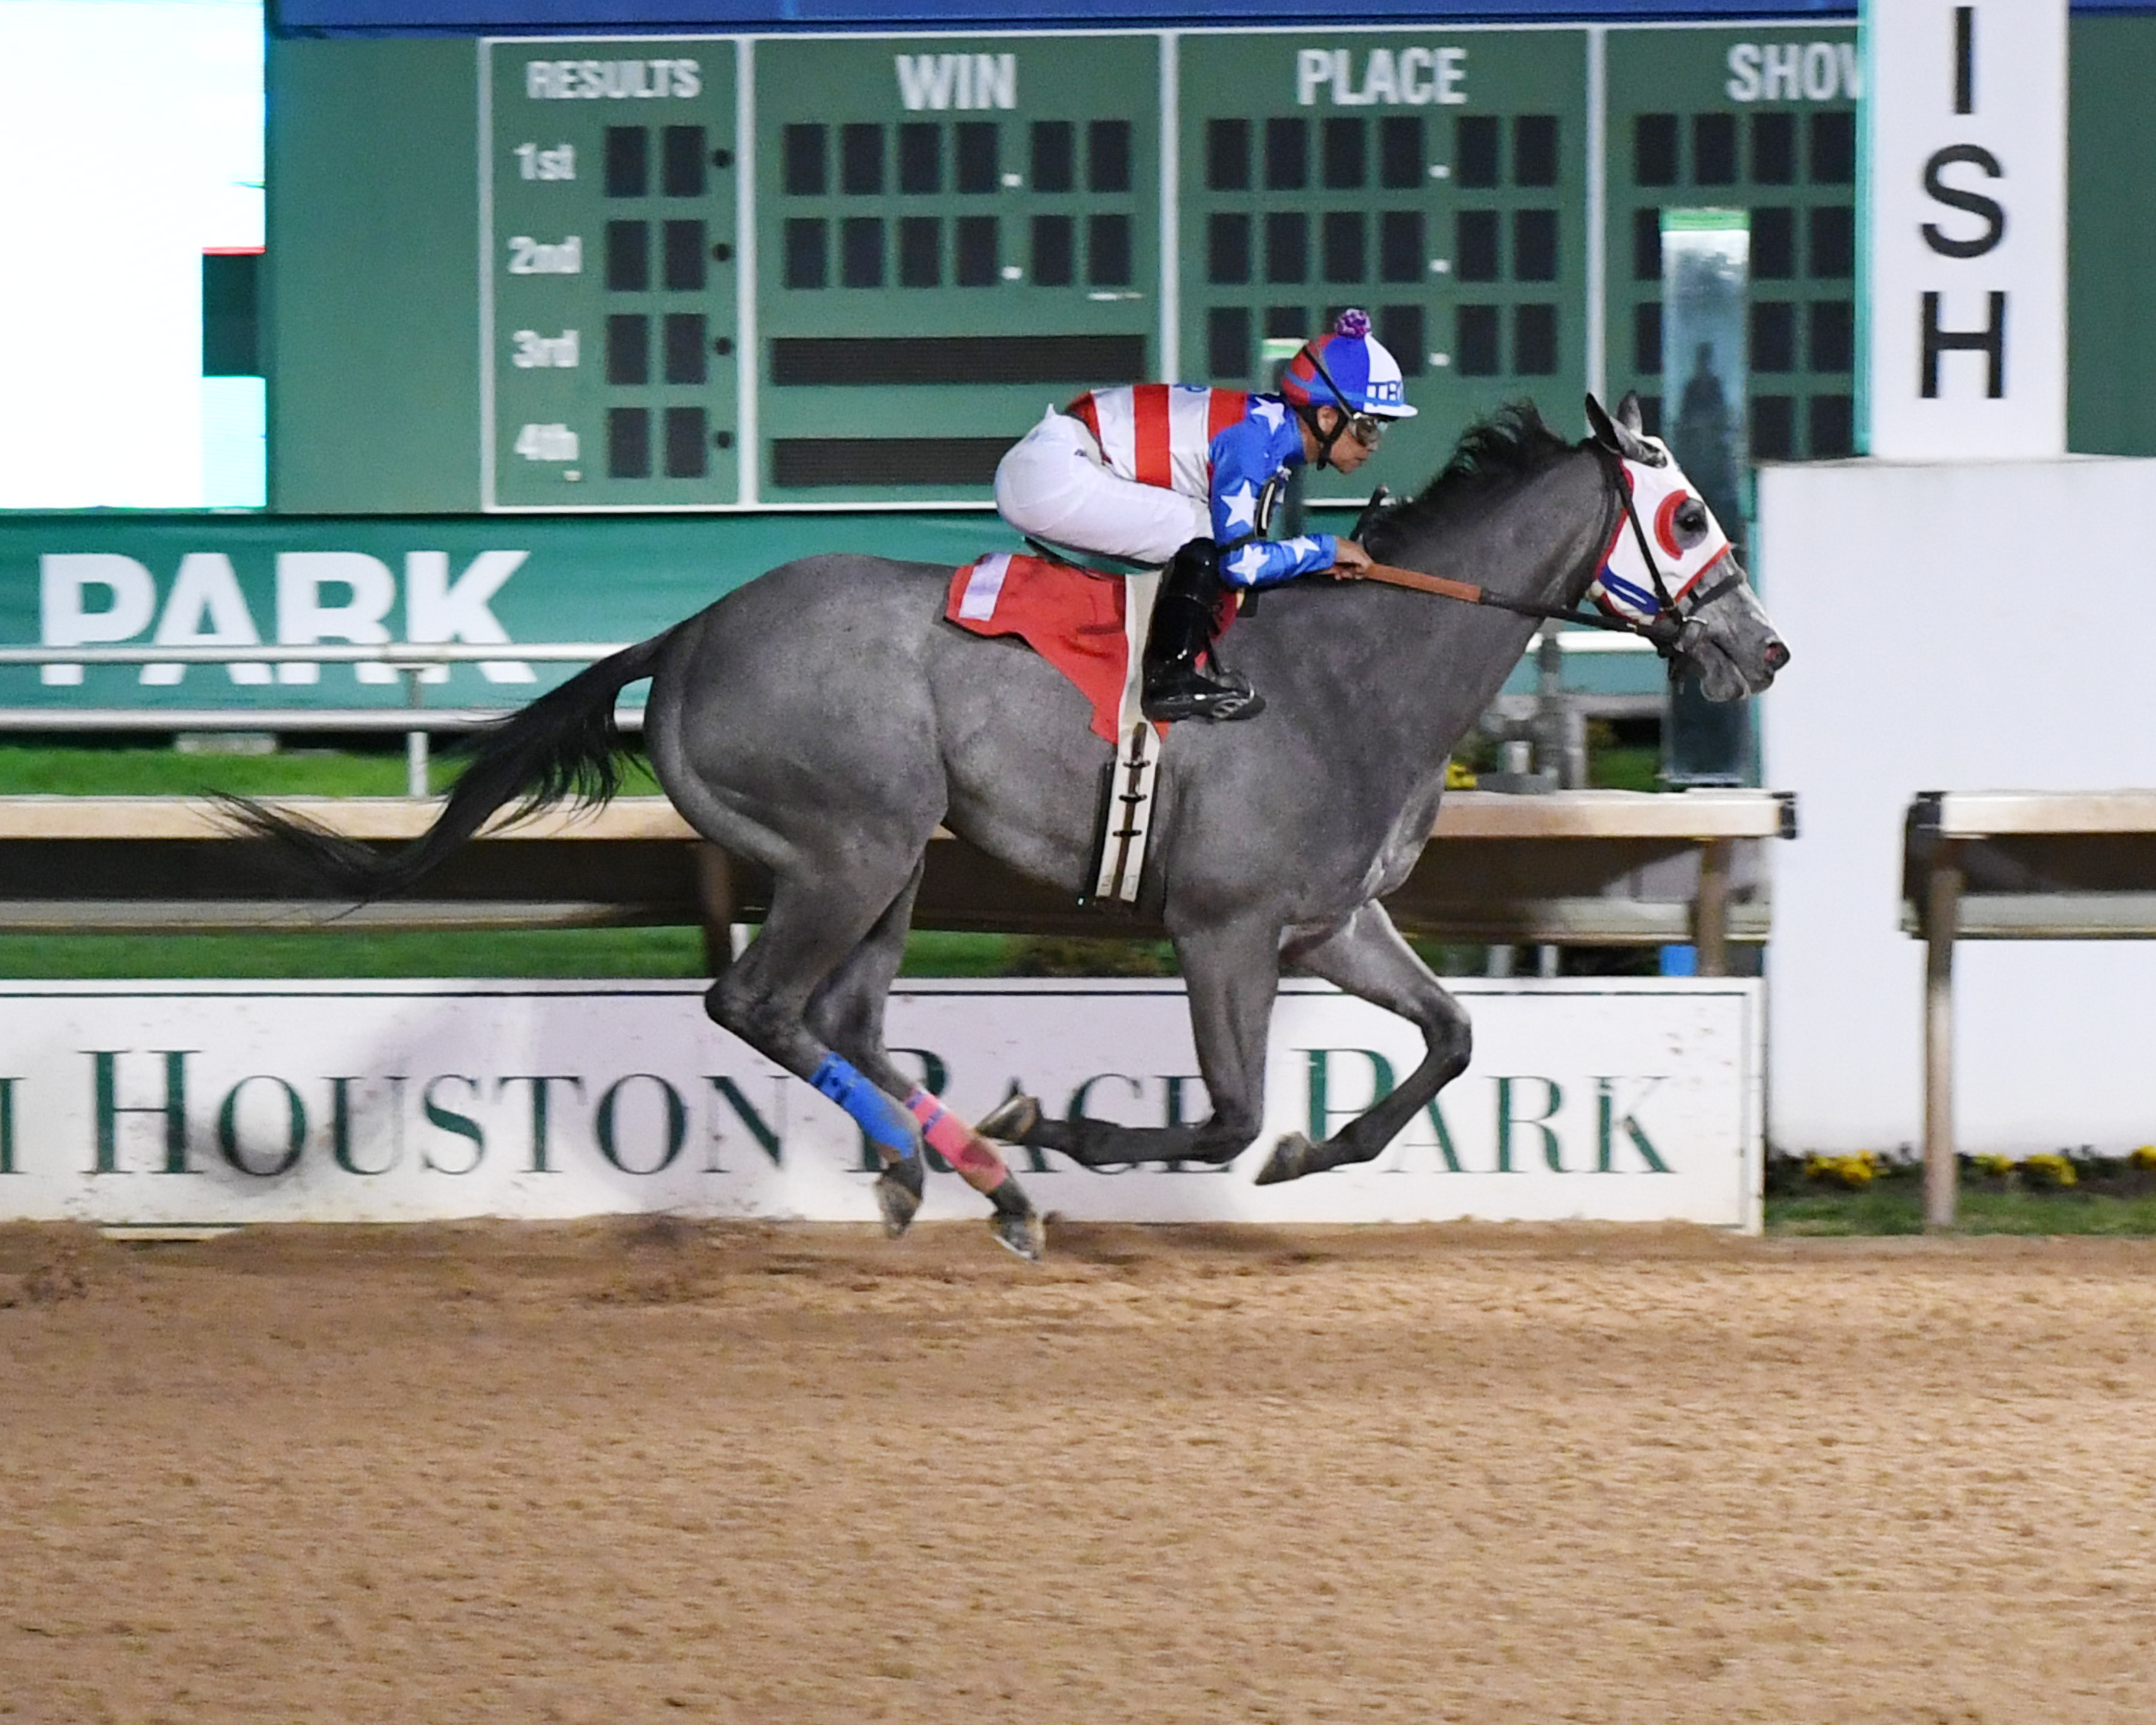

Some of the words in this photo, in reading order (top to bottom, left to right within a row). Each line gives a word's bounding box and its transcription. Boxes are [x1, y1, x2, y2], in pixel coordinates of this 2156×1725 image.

[526, 59, 702, 99] RESULTS
[896, 54, 1016, 110] WIN
[1297, 47, 1467, 105] PLACE
[513, 143, 576, 180] 1st
[508, 237, 582, 273] 2nd
[513, 329, 579, 367] 3rd
[40, 550, 537, 685] PARK
[78, 1049, 791, 1176] HOUSTON
